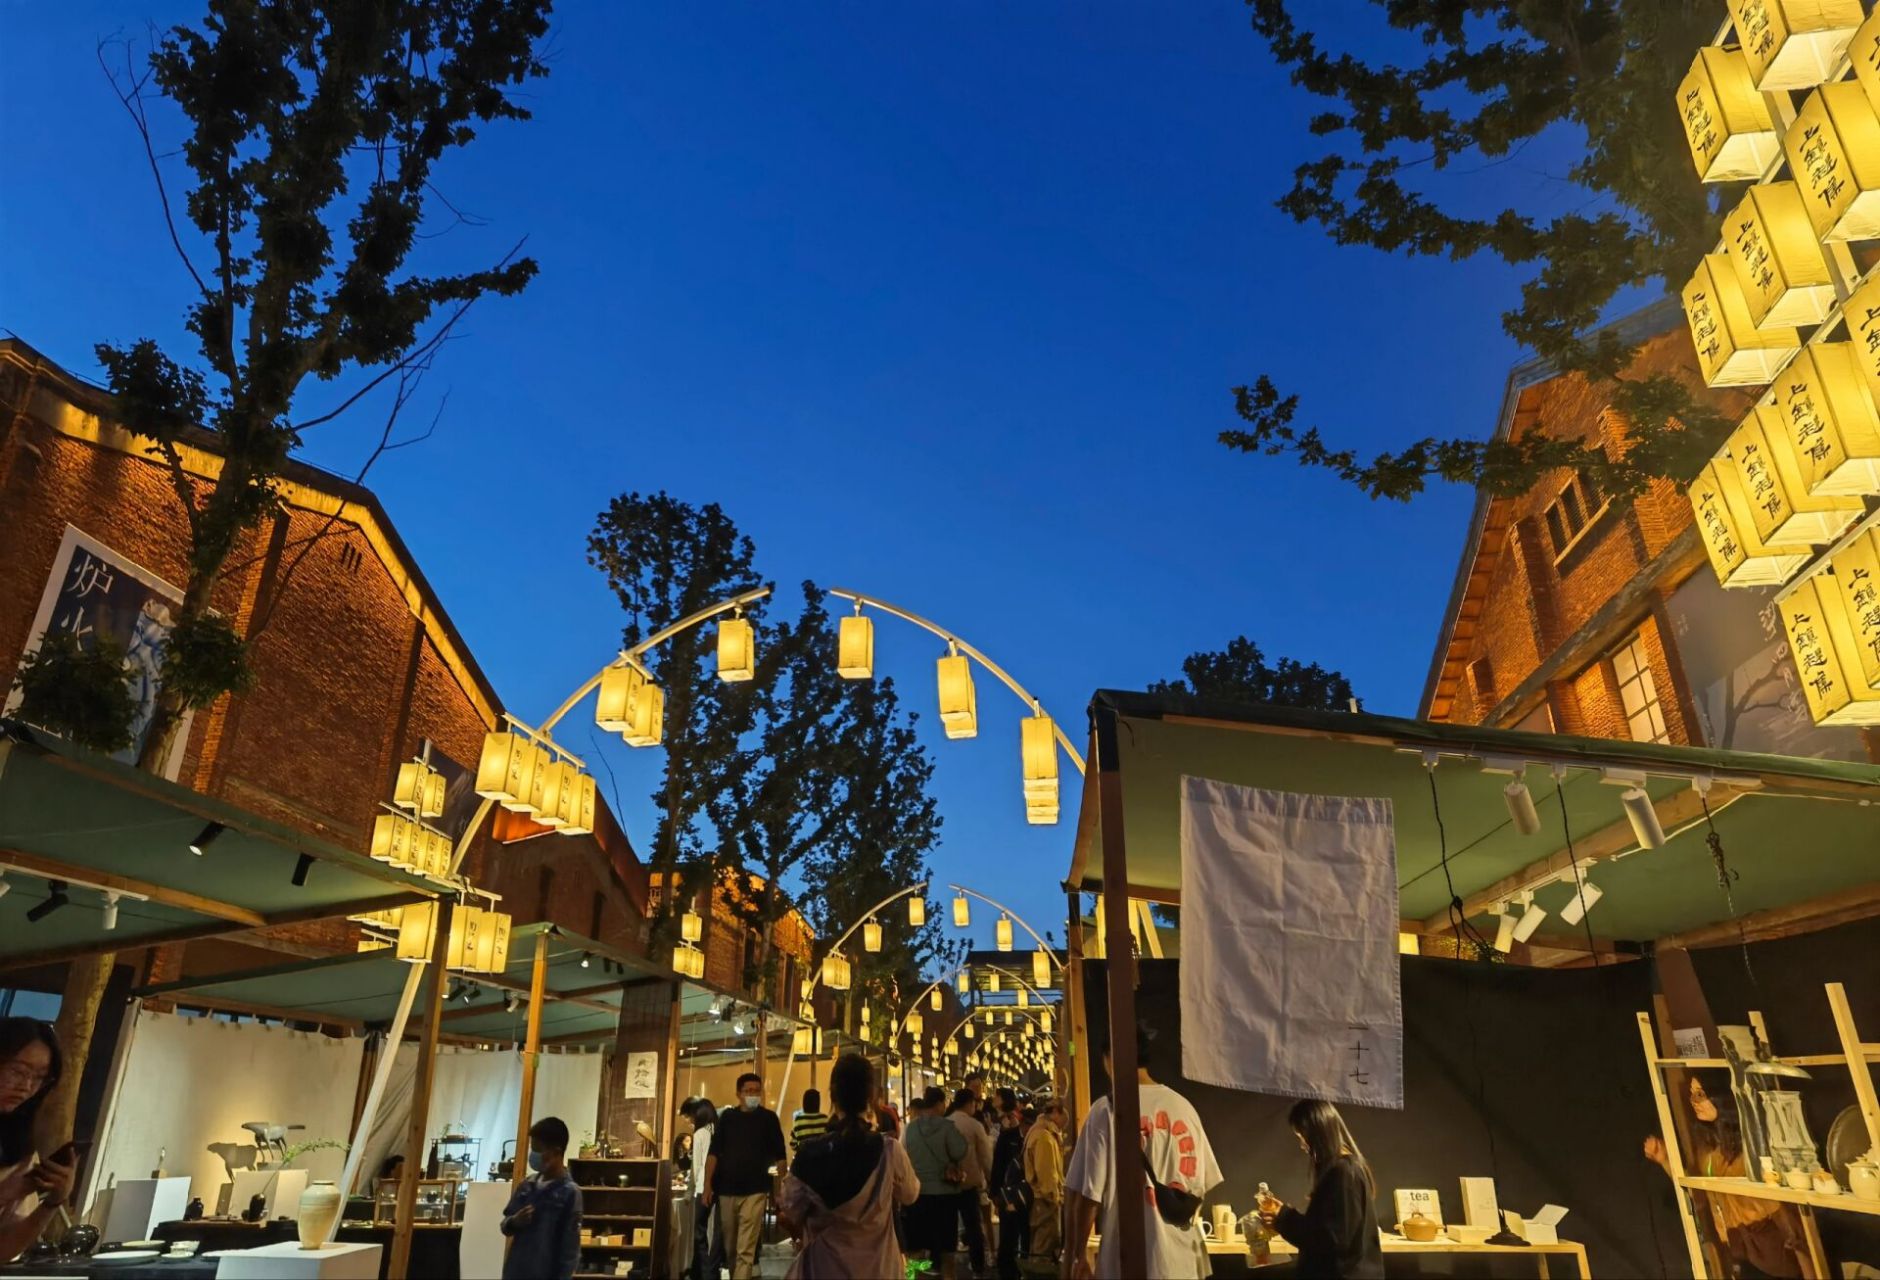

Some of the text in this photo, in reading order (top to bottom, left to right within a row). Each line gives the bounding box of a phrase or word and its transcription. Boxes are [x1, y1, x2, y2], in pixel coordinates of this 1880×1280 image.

[1348, 1026, 1370, 1085] 一十七
[1410, 1191, 1430, 1201] tea
